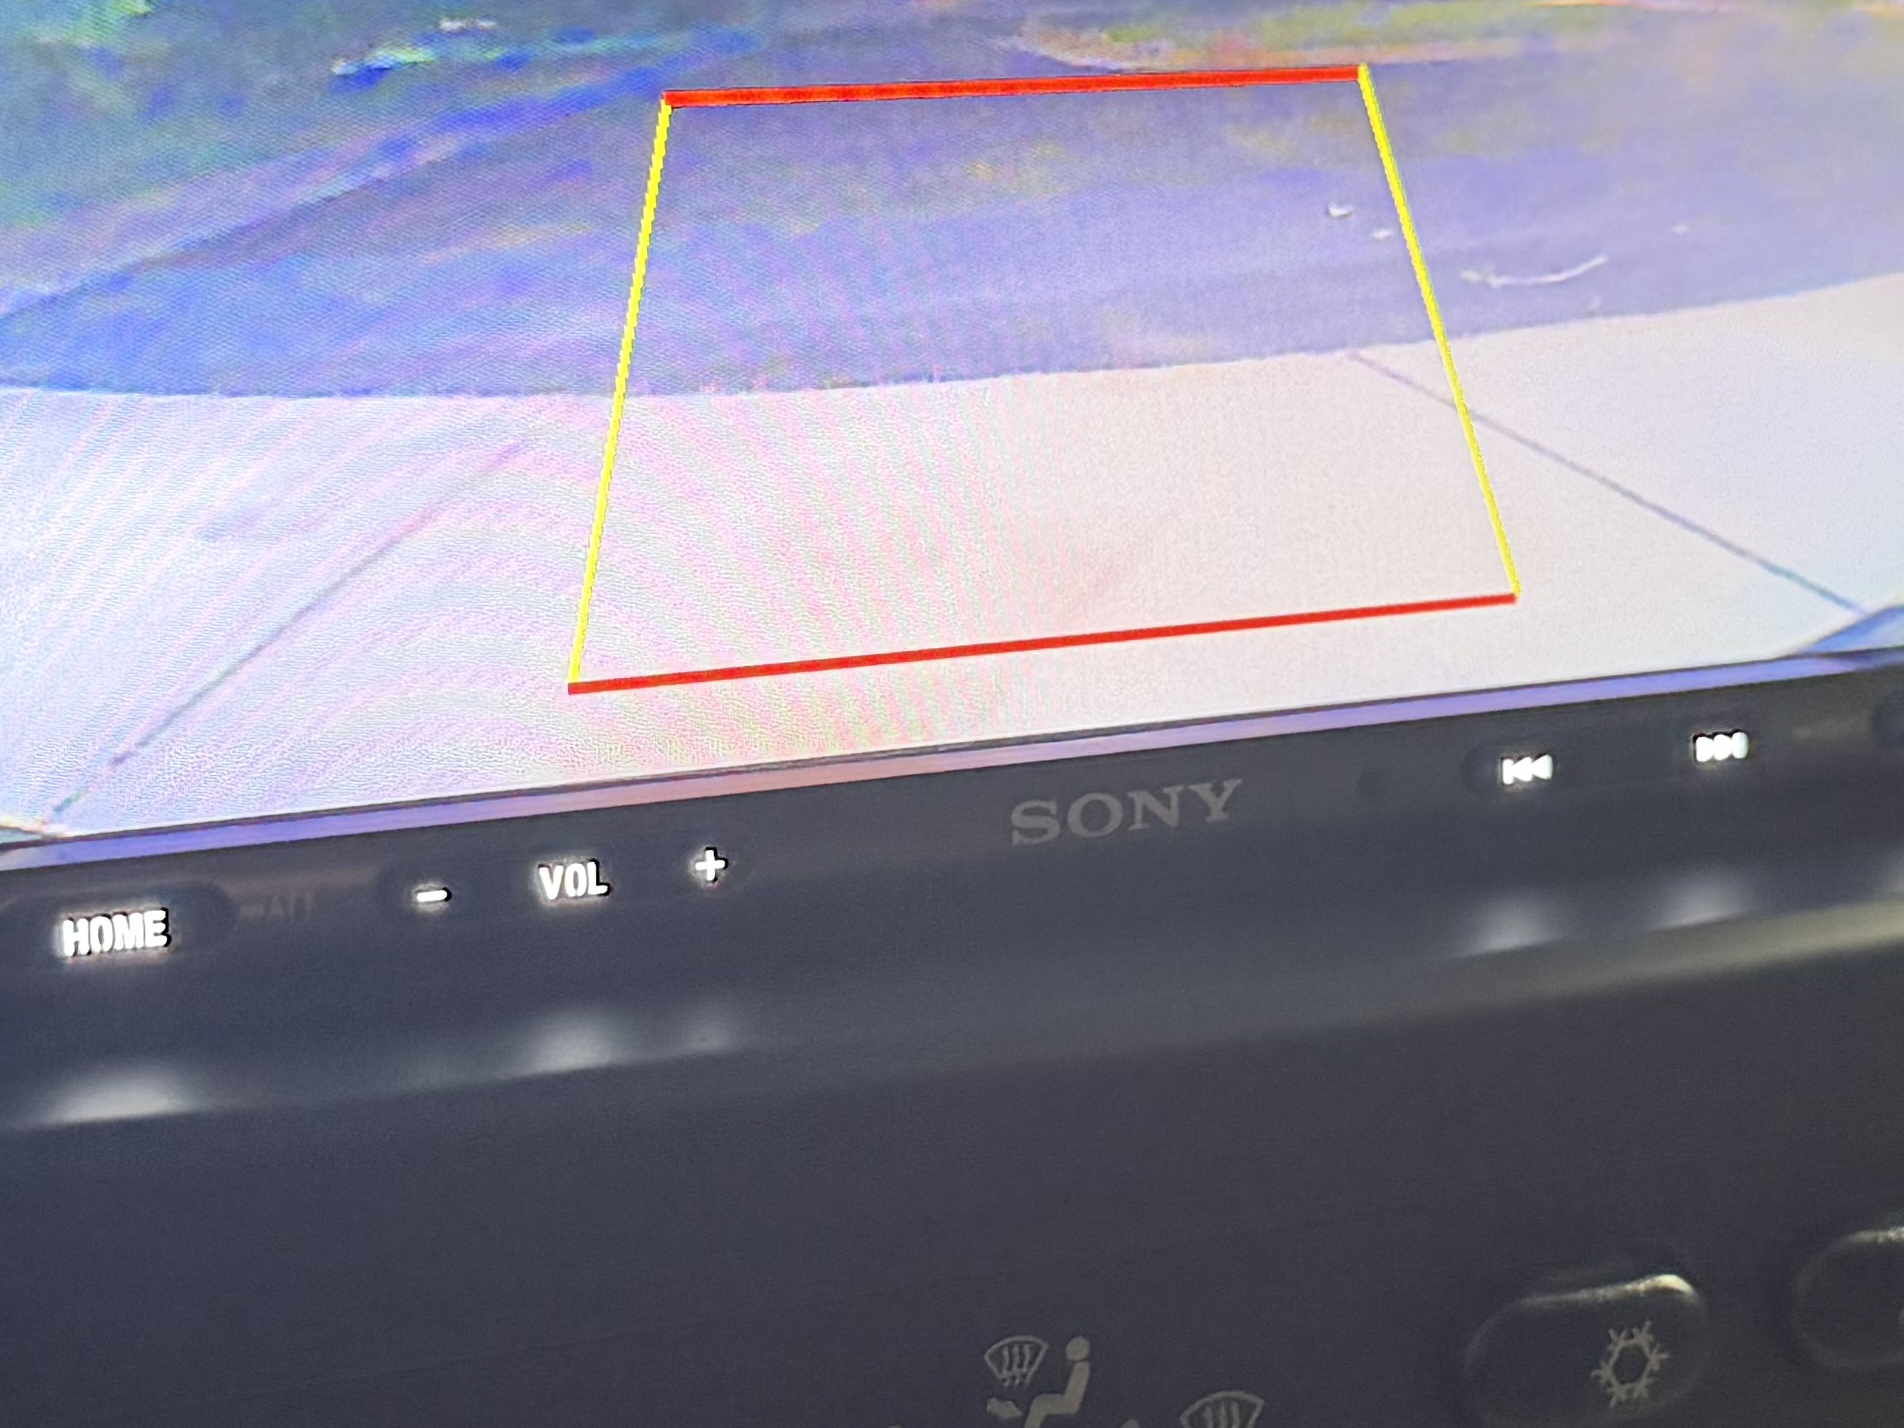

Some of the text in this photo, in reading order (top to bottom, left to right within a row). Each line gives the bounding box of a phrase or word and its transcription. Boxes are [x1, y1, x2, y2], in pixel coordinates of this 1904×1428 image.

[1009, 778, 1244, 847] SONY
[537, 858, 611, 903] VOL
[61, 906, 172, 958] HOME
